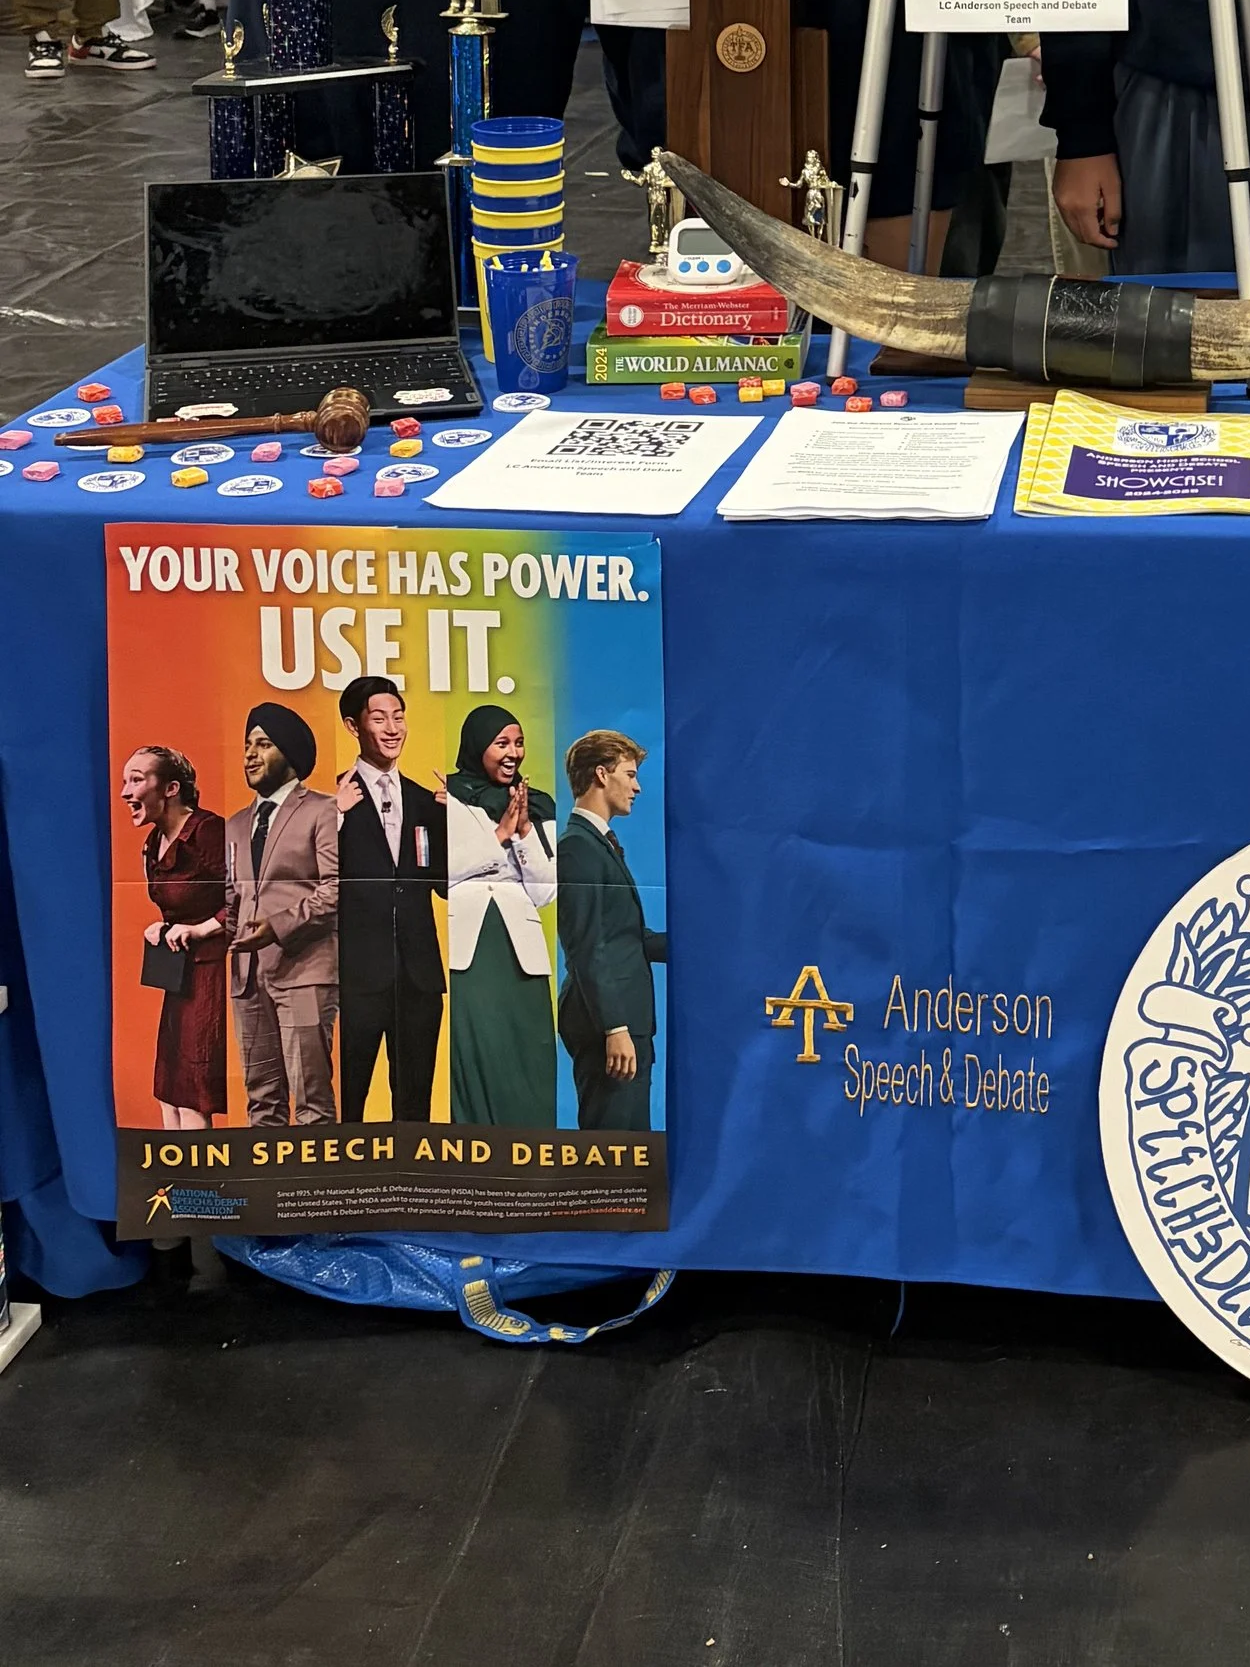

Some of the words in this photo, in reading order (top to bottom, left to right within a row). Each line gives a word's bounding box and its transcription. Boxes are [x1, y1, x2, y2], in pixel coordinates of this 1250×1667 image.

[939, 1, 953, 11] LC
[954, 1, 1001, 11] Anderson
[1003, 1, 1039, 13] Speech
[1041, 1, 1060, 11] and
[1062, 1, 1098, 11] Debate
[1004, 15, 1032, 25] Team
[730, 41, 754, 53] TFA
[664, 302, 679, 310] The
[680, 301, 750, 310] Merriam-Webster
[660, 311, 753, 332] Dictionary
[594, 347, 608, 382] 2024
[615, 356, 624, 373] THE
[623, 356, 690, 373] WORLD
[691, 356, 779, 373] ALMANAC
[1085, 451, 1155, 465] ANDERSON
[1190, 457, 1242, 465] SCHOOL
[1097, 460, 1147, 469] SPEECH
[1094, 474, 1224, 490] SHOWCASE!
[1124, 488, 1200, 497] 2024-2025
[118, 545, 244, 592] YOUR
[251, 548, 378, 596] VOICE
[387, 550, 475, 597] HAS
[483, 552, 650, 602] POWER.
[260, 605, 406, 692] USE
[427, 608, 516, 695] IT.
[882, 973, 1053, 1039] Anderson
[843, 1043, 934, 1118] Speech
[938, 1046, 957, 1106] &
[964, 1052, 1051, 1115] Debate
[1134, 1054, 1234, 1234] SPEECH
[141, 1142, 231, 1170] JOIN
[252, 1136, 395, 1166] SPEECH
[414, 1137, 492, 1163] AND
[511, 1142, 651, 1167] DEBATE
[171, 1188, 221, 1199] NATIONAL
[356, 1187, 381, 1196] Speech
[413, 1186, 450, 1194] Association
[516, 1191, 547, 1199] authority
[558, 1190, 580, 1198] public
[581, 1188, 609, 1196] speaking
[297, 1199, 321, 1207] United
[358, 1197, 379, 1205] NSDA
[434, 1198, 462, 1207] platform
[474, 1199, 493, 1207] youth
[589, 1197, 629, 1206] culminating
[277, 1210, 306, 1218] National
[307, 1210, 332, 1218] Speech
[365, 1206, 406, 1214] Tournament,
[455, 1208, 476, 1216] public
